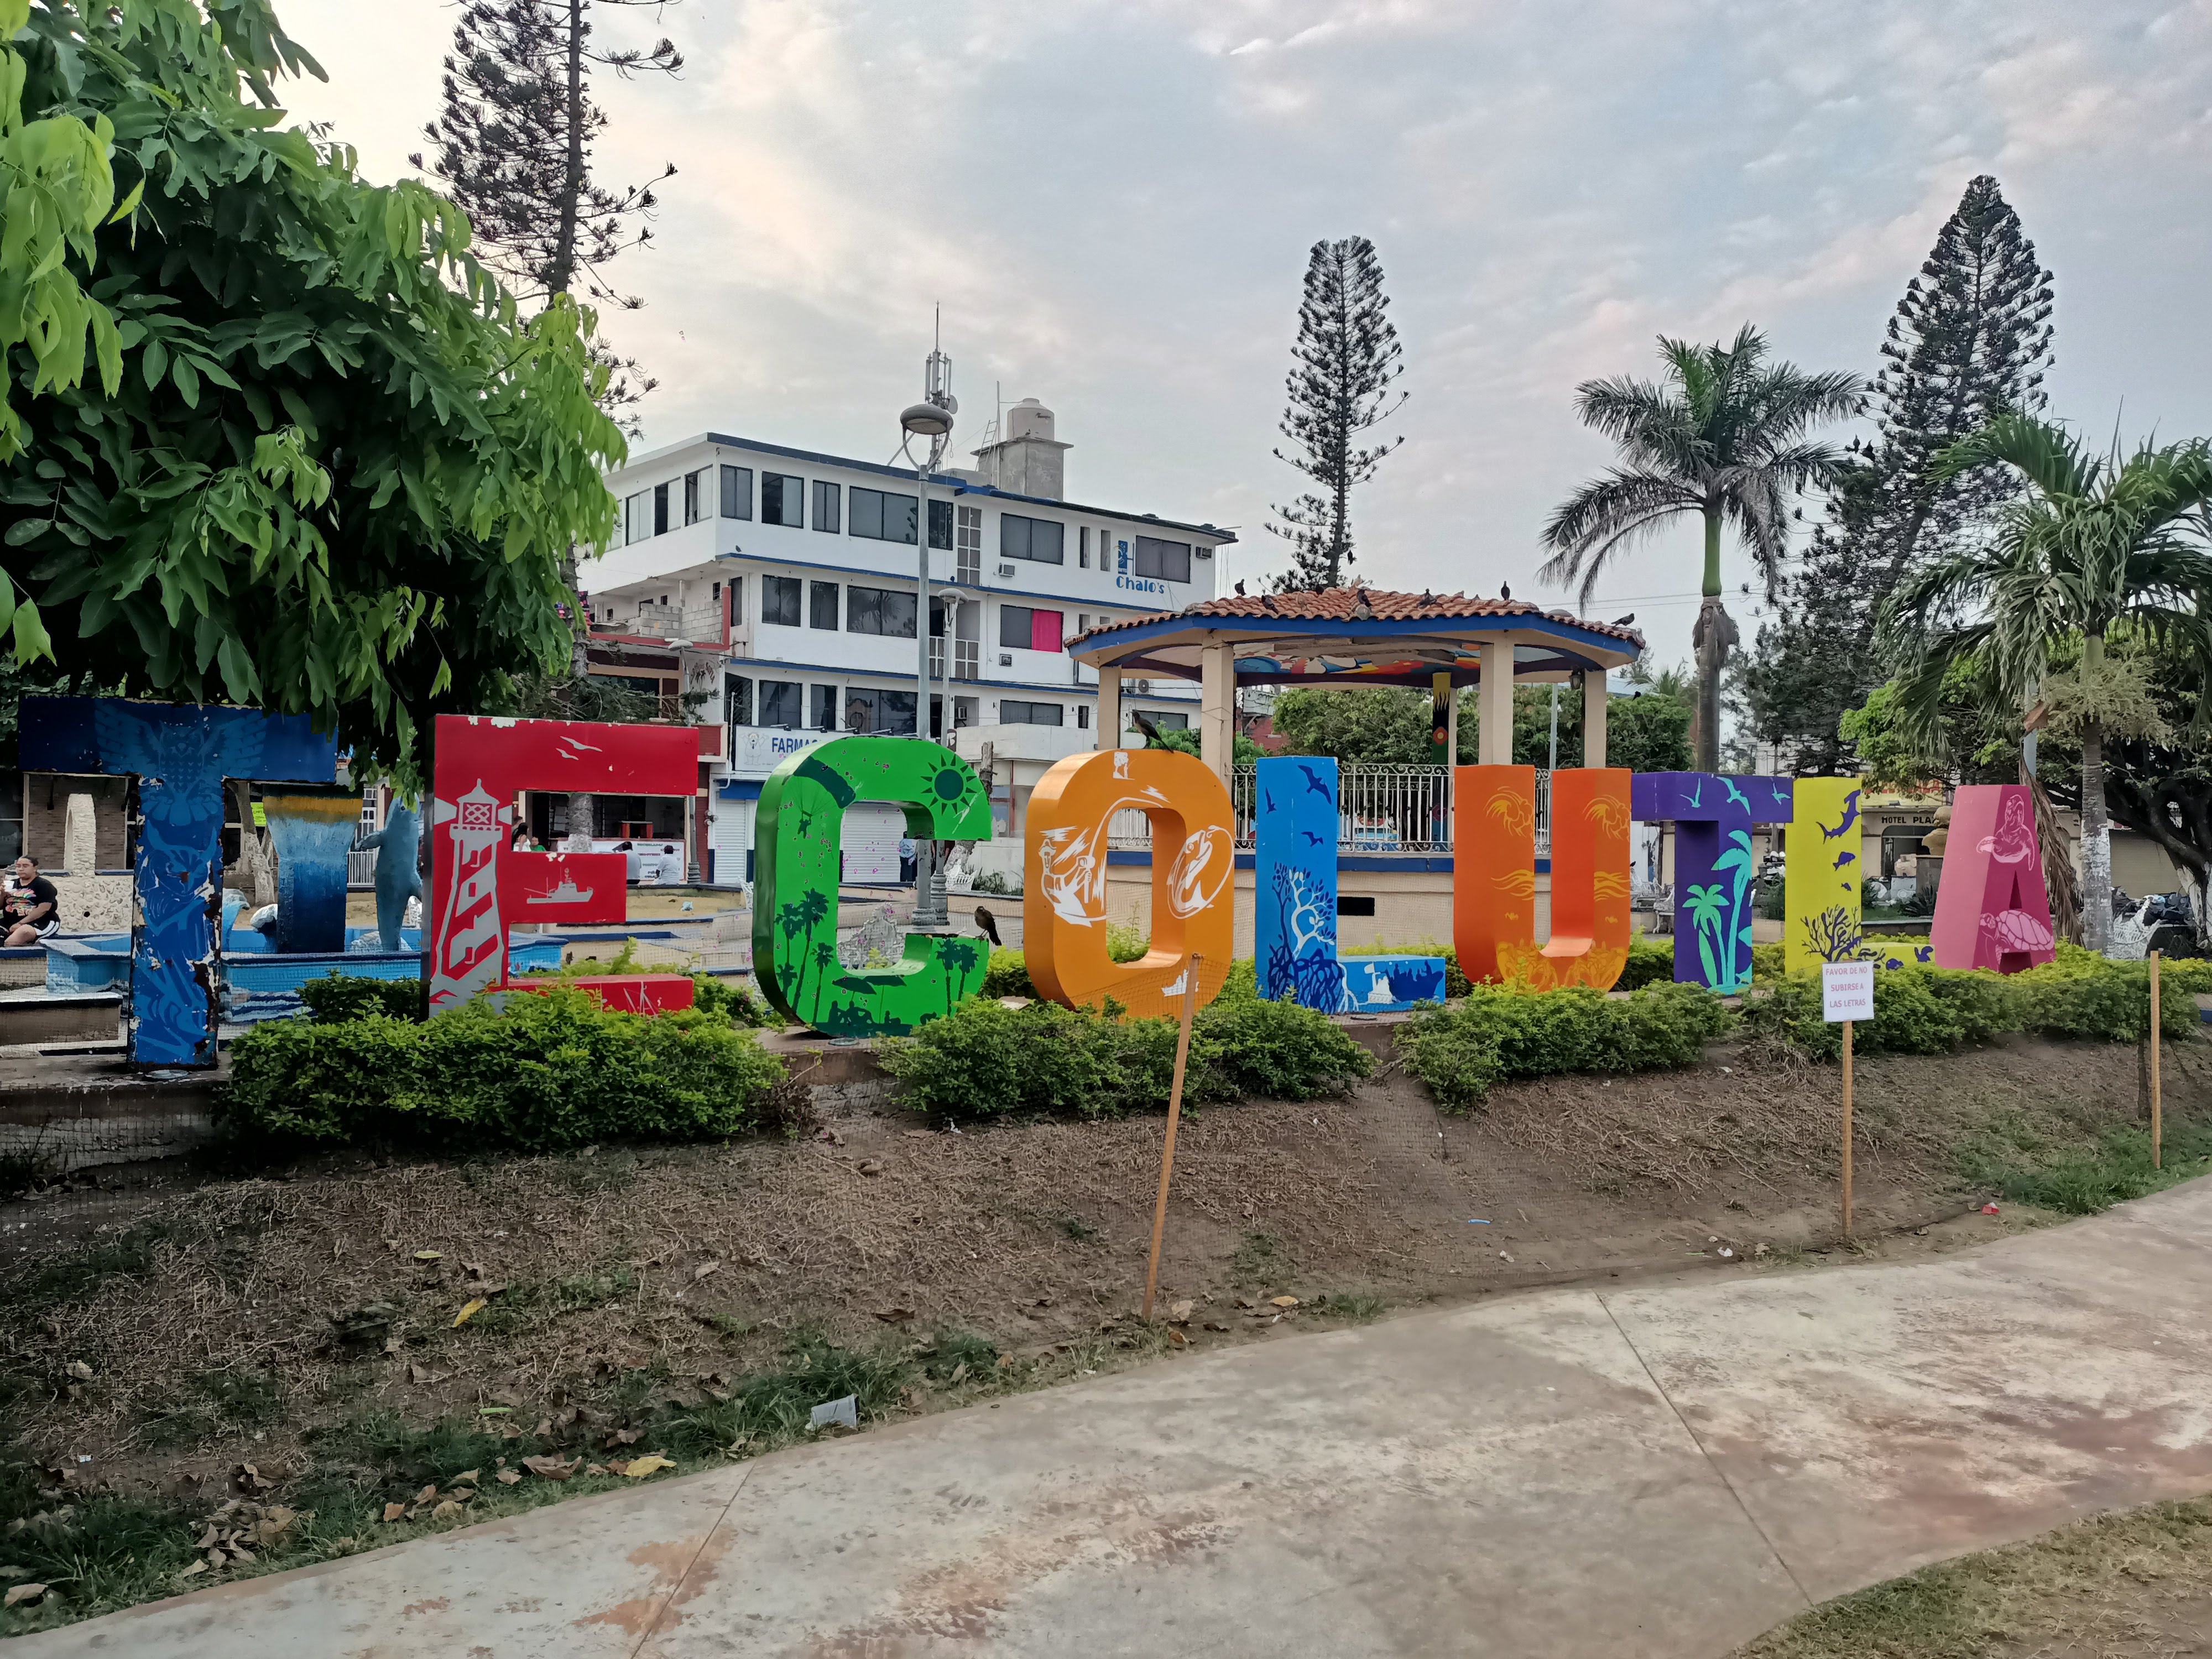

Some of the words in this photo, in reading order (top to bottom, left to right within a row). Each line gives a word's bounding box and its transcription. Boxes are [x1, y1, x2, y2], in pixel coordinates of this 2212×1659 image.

[1117, 576, 1165, 594] Chalo's
[772, 737, 818, 753] FARM
[18, 693, 2056, 1071] TECOLUTLA
[1831, 983, 1858, 992] SUBIRSE
